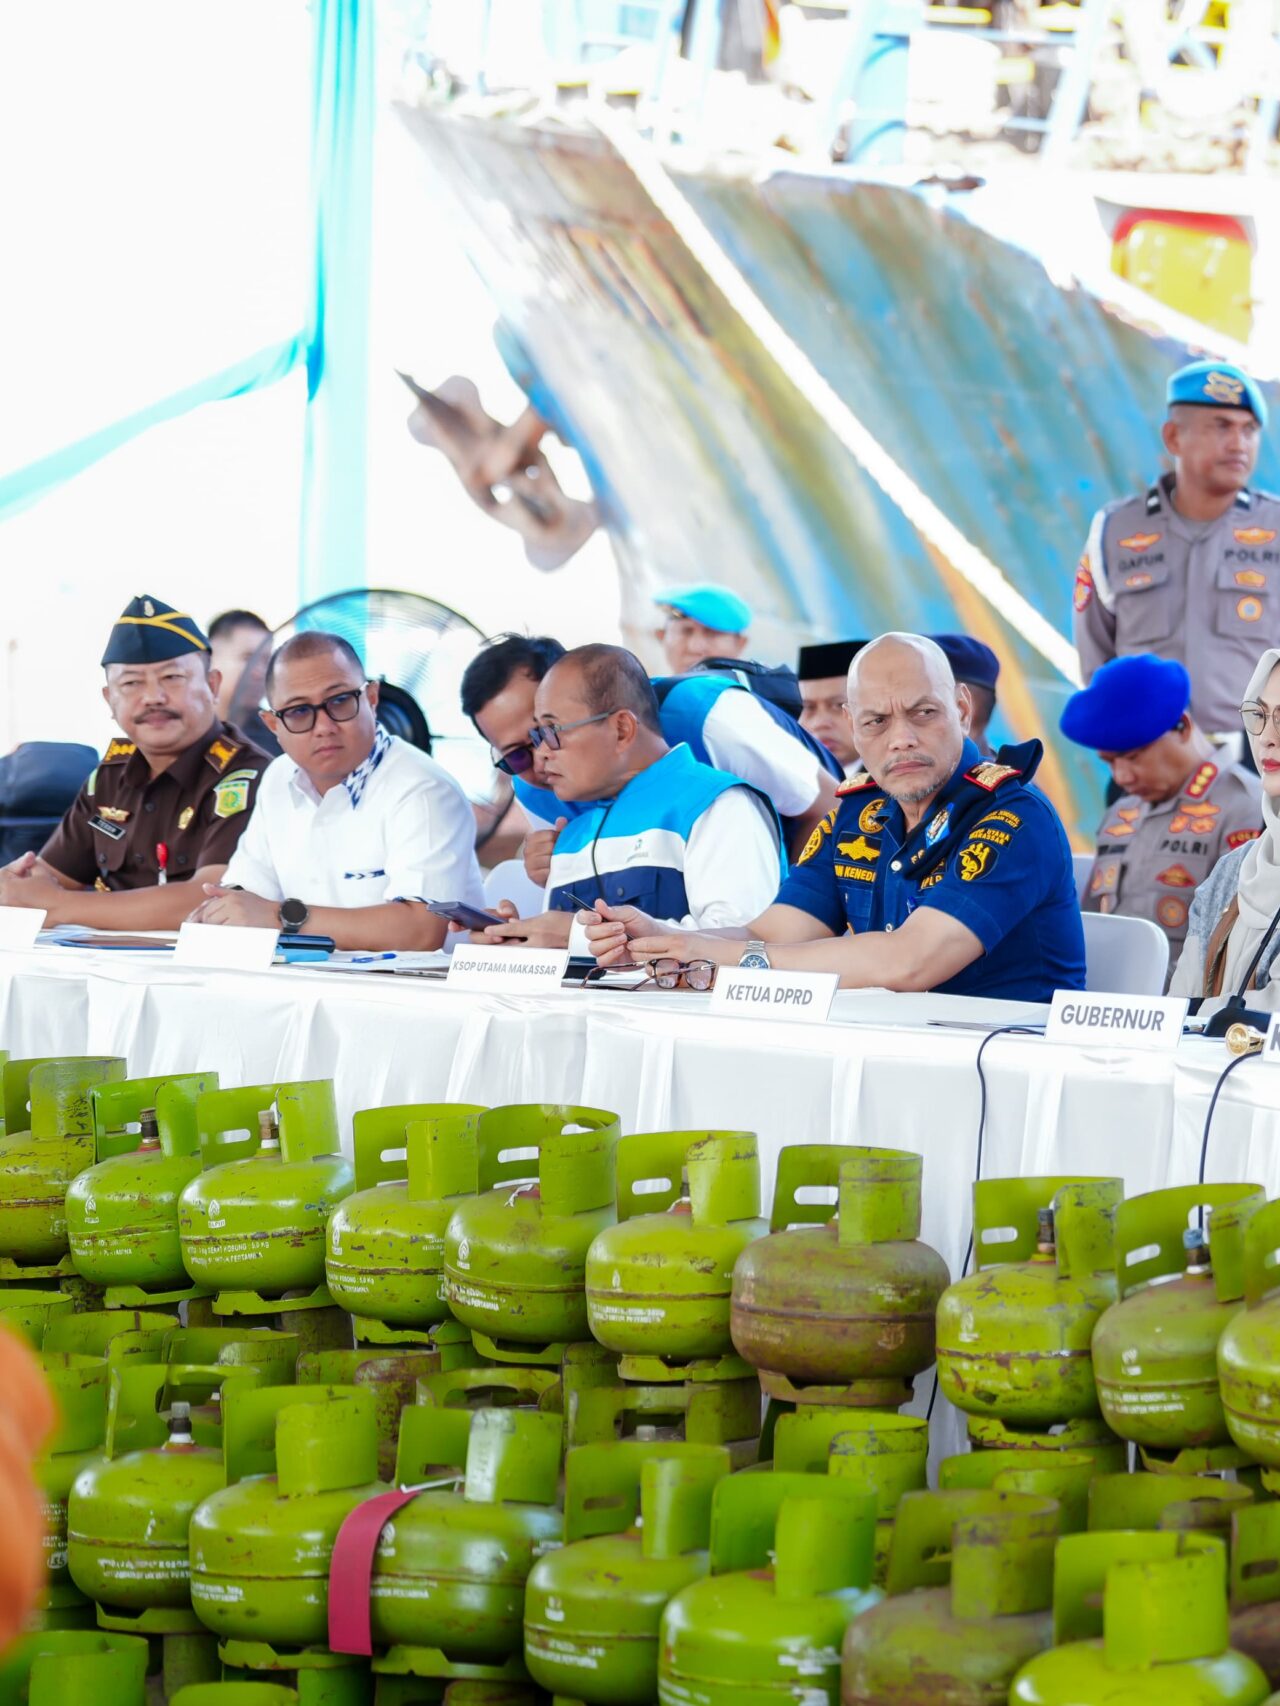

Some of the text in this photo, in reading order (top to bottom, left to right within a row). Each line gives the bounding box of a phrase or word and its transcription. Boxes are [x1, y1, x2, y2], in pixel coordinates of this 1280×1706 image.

[1224, 548, 1280, 563] POLRI
[1160, 839, 1209, 855] POLRI
[453, 960, 557, 975] KSOP UTAMA MAKASSAR
[726, 984, 813, 1005] KETUA DPRD
[1060, 1004, 1165, 1031] GUBERNUR
